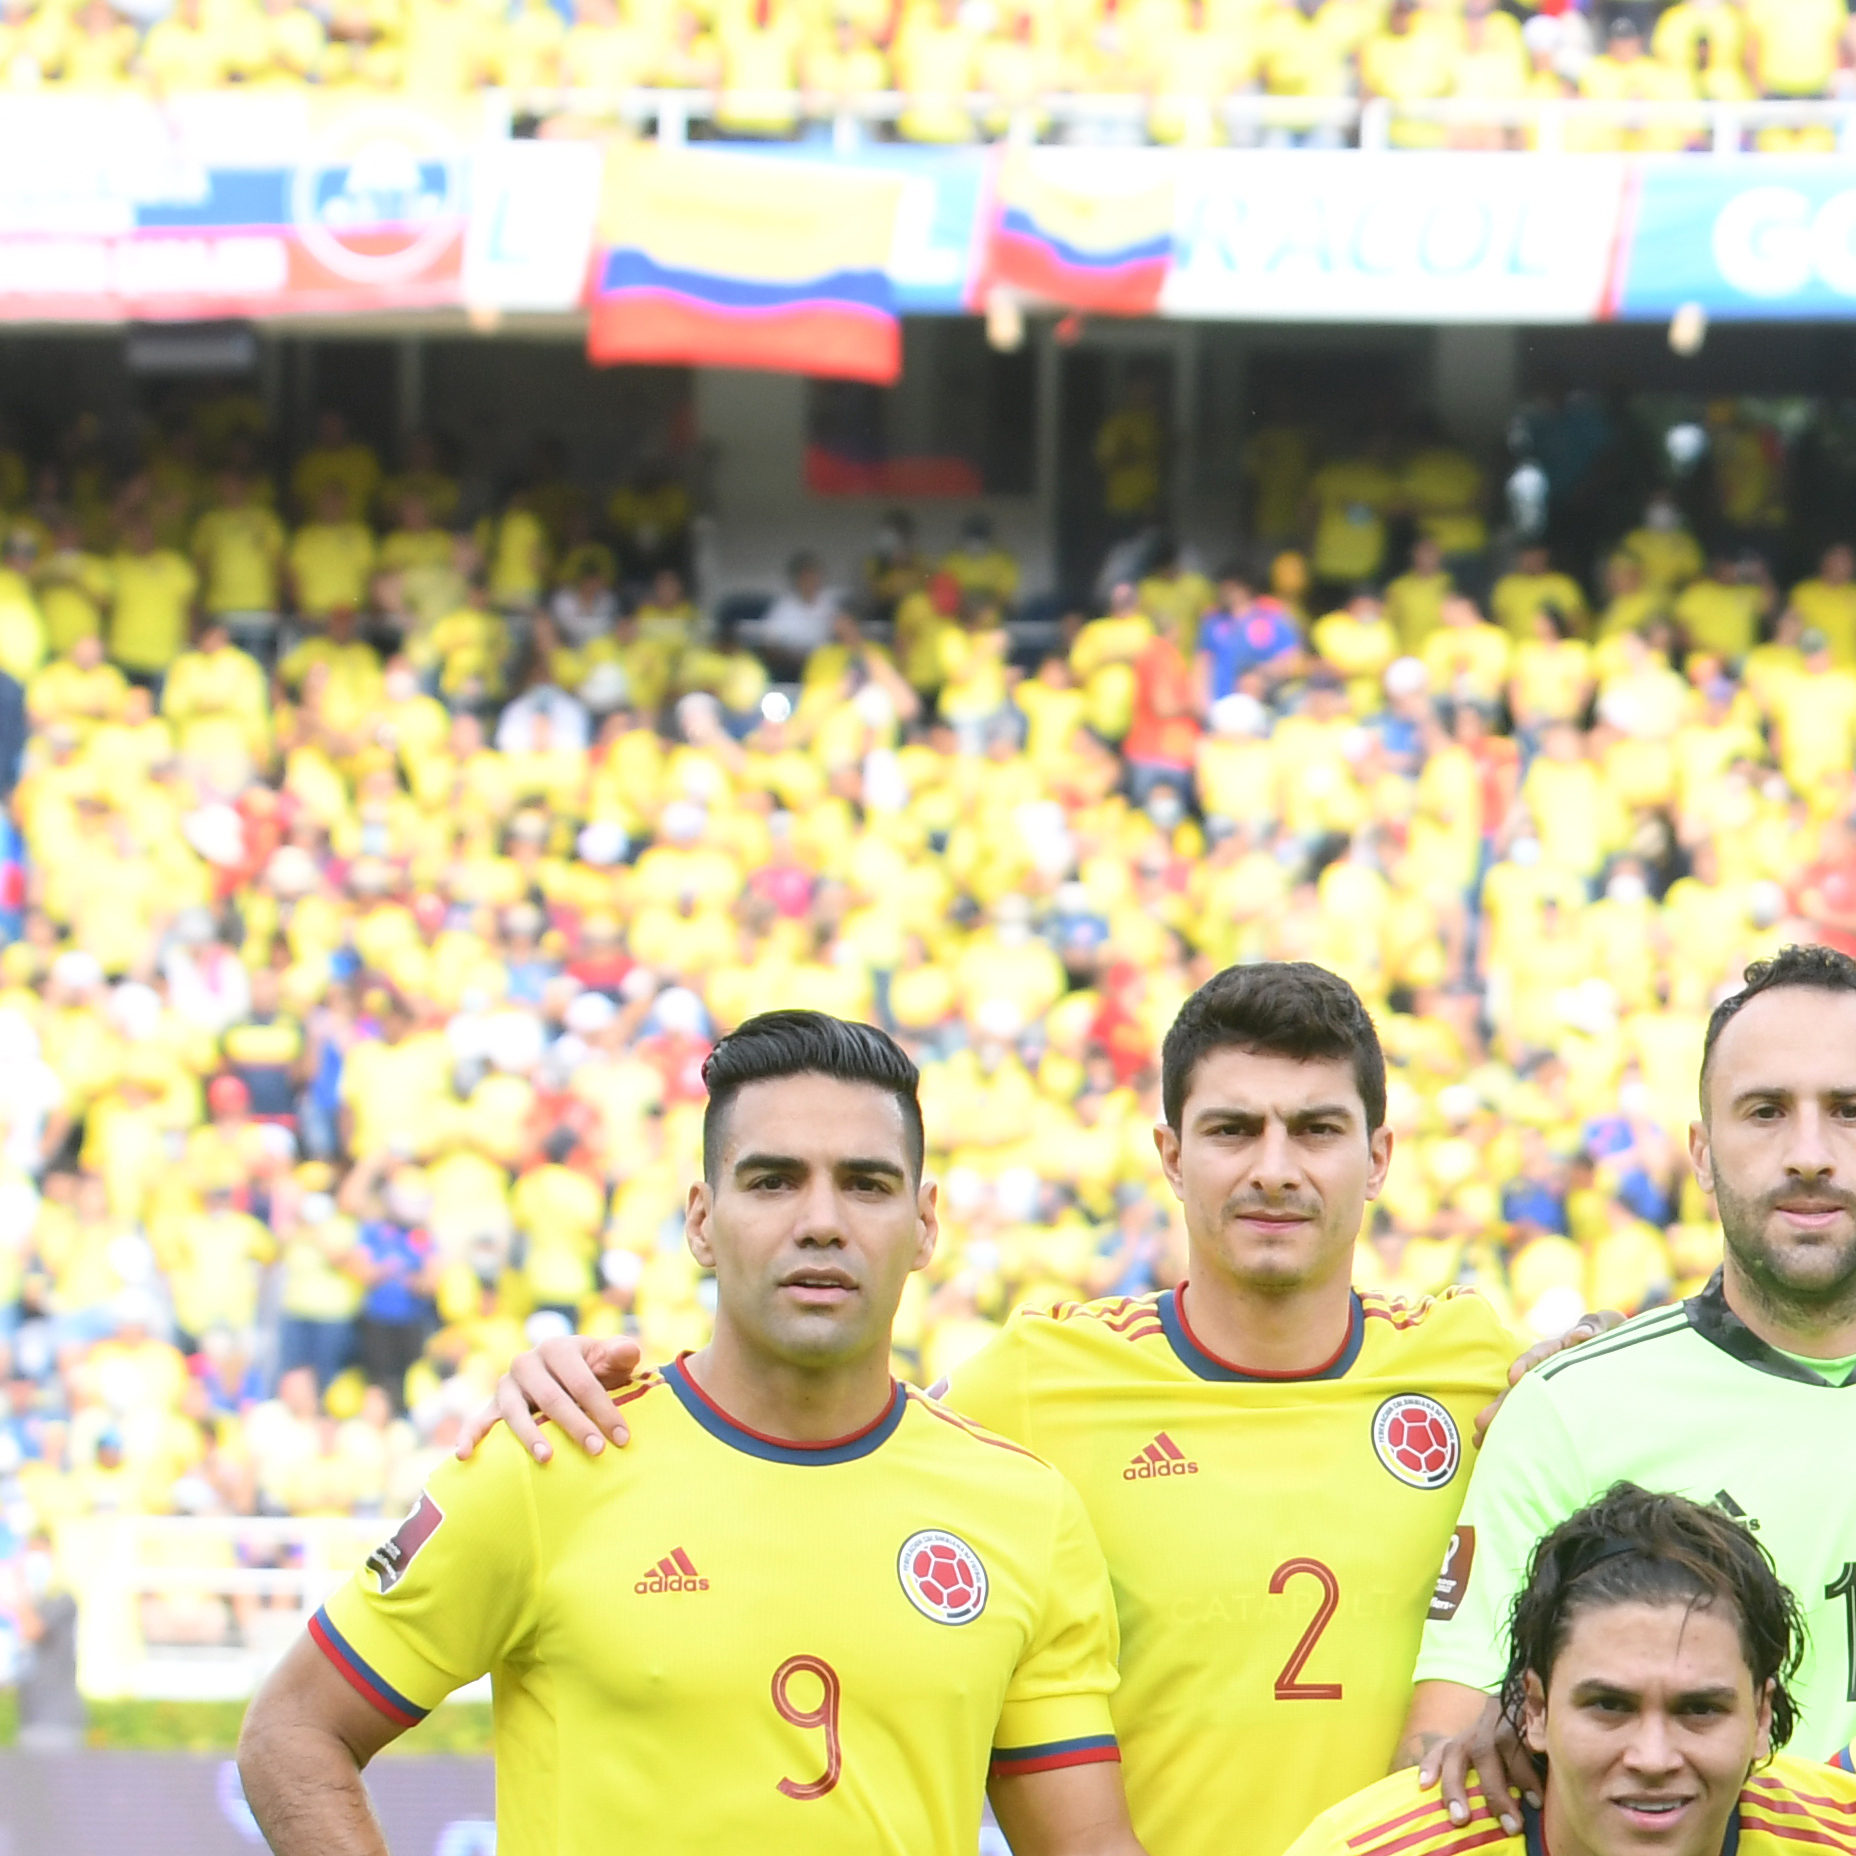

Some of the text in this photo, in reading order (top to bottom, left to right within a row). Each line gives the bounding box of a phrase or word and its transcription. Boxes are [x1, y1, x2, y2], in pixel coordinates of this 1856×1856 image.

[1176, 195, 1553, 278] RACOL
[1123, 1457, 1199, 1481] adidas
[634, 1573, 710, 1595] adidas
[1267, 1557, 1343, 1701] 2
[770, 1653, 842, 1801] 9
